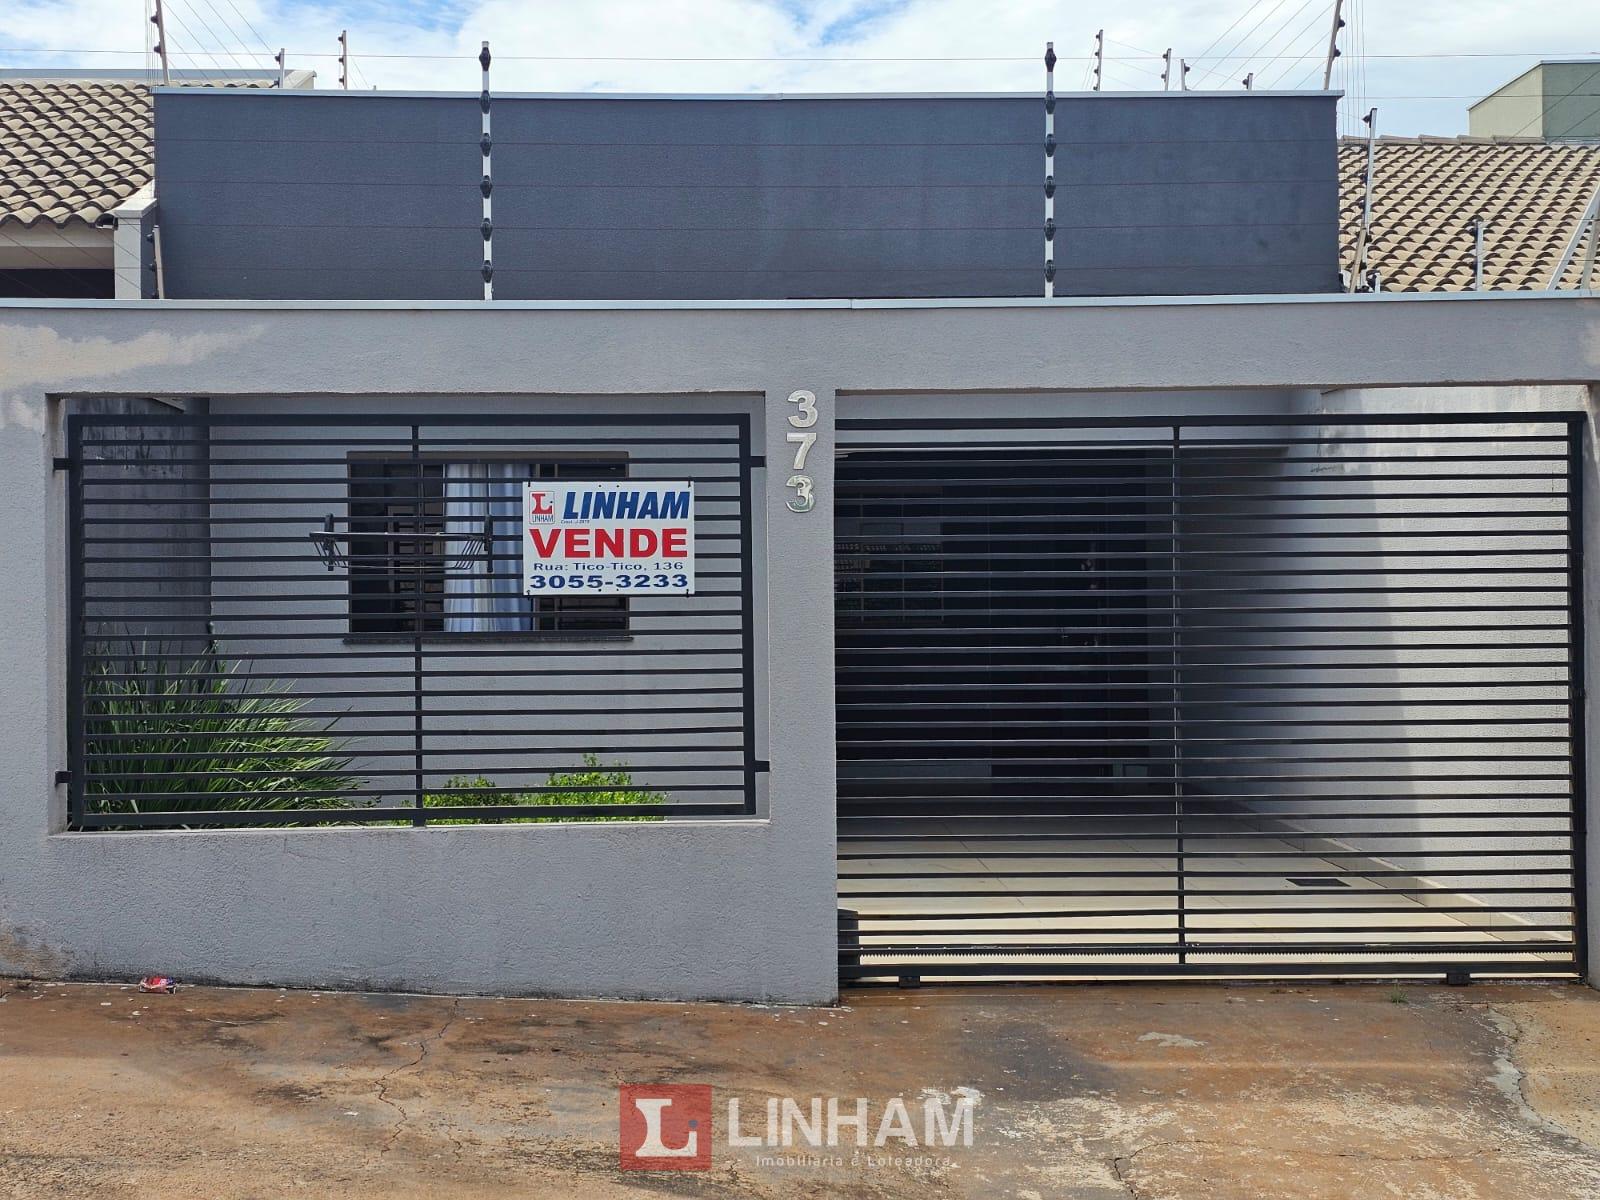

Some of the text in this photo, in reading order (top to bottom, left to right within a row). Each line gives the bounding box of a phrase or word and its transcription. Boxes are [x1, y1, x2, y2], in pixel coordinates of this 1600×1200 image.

[786, 389, 819, 513] 373
[563, 491, 691, 520] LINHAM
[529, 528, 688, 558] VENDE
[533, 562, 569, 571] Rua:
[653, 562, 684, 571] 136
[530, 574, 689, 589] 3055-3233
